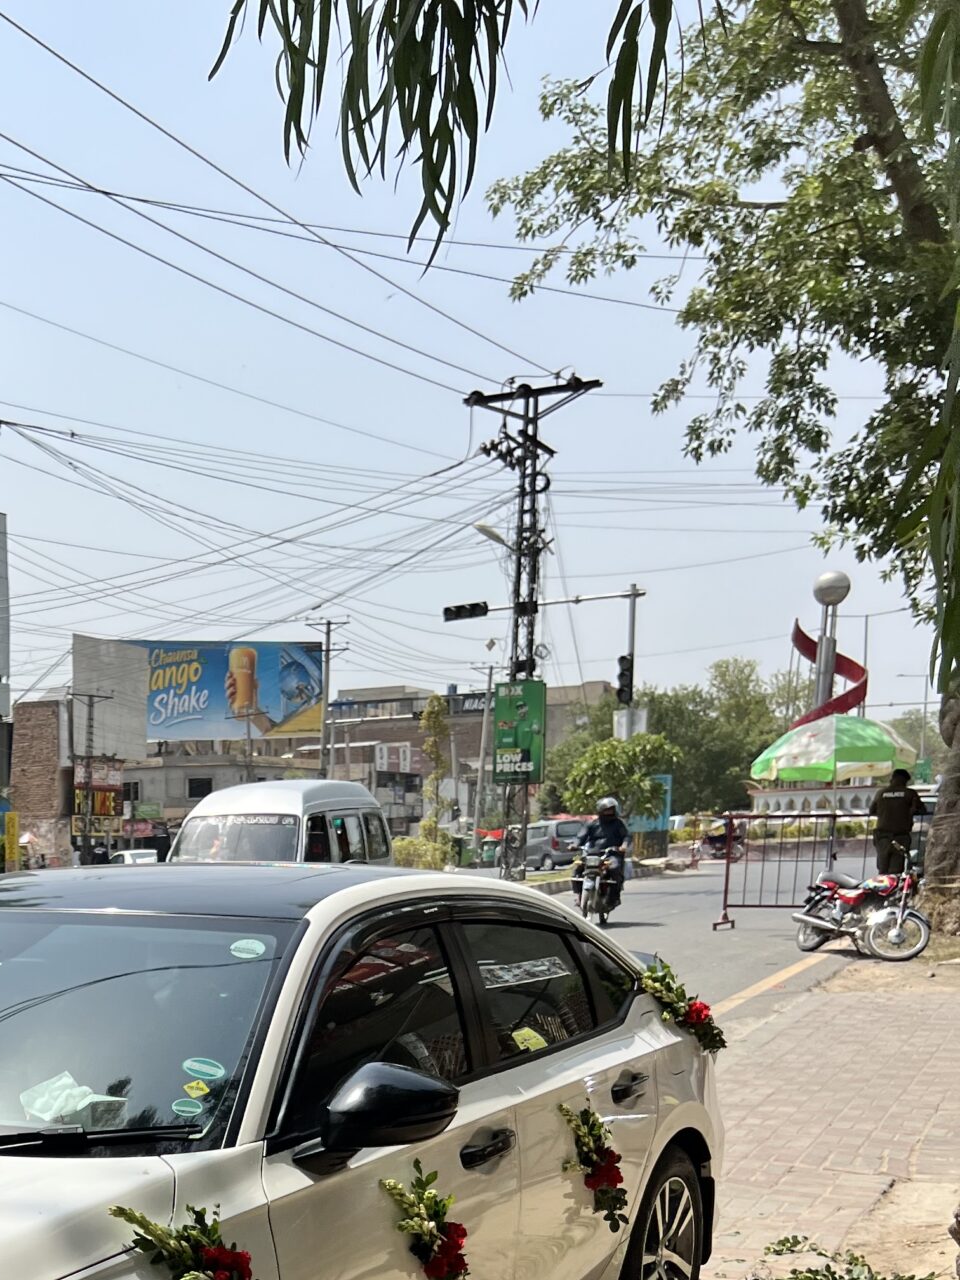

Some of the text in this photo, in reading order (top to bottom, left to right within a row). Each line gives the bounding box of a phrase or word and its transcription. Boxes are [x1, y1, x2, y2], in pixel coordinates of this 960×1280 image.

[146, 662, 203, 695] ango
[150, 685, 209, 725] Shake
[495, 761, 535, 773] PRICES
[496, 752, 523, 763] LOW
